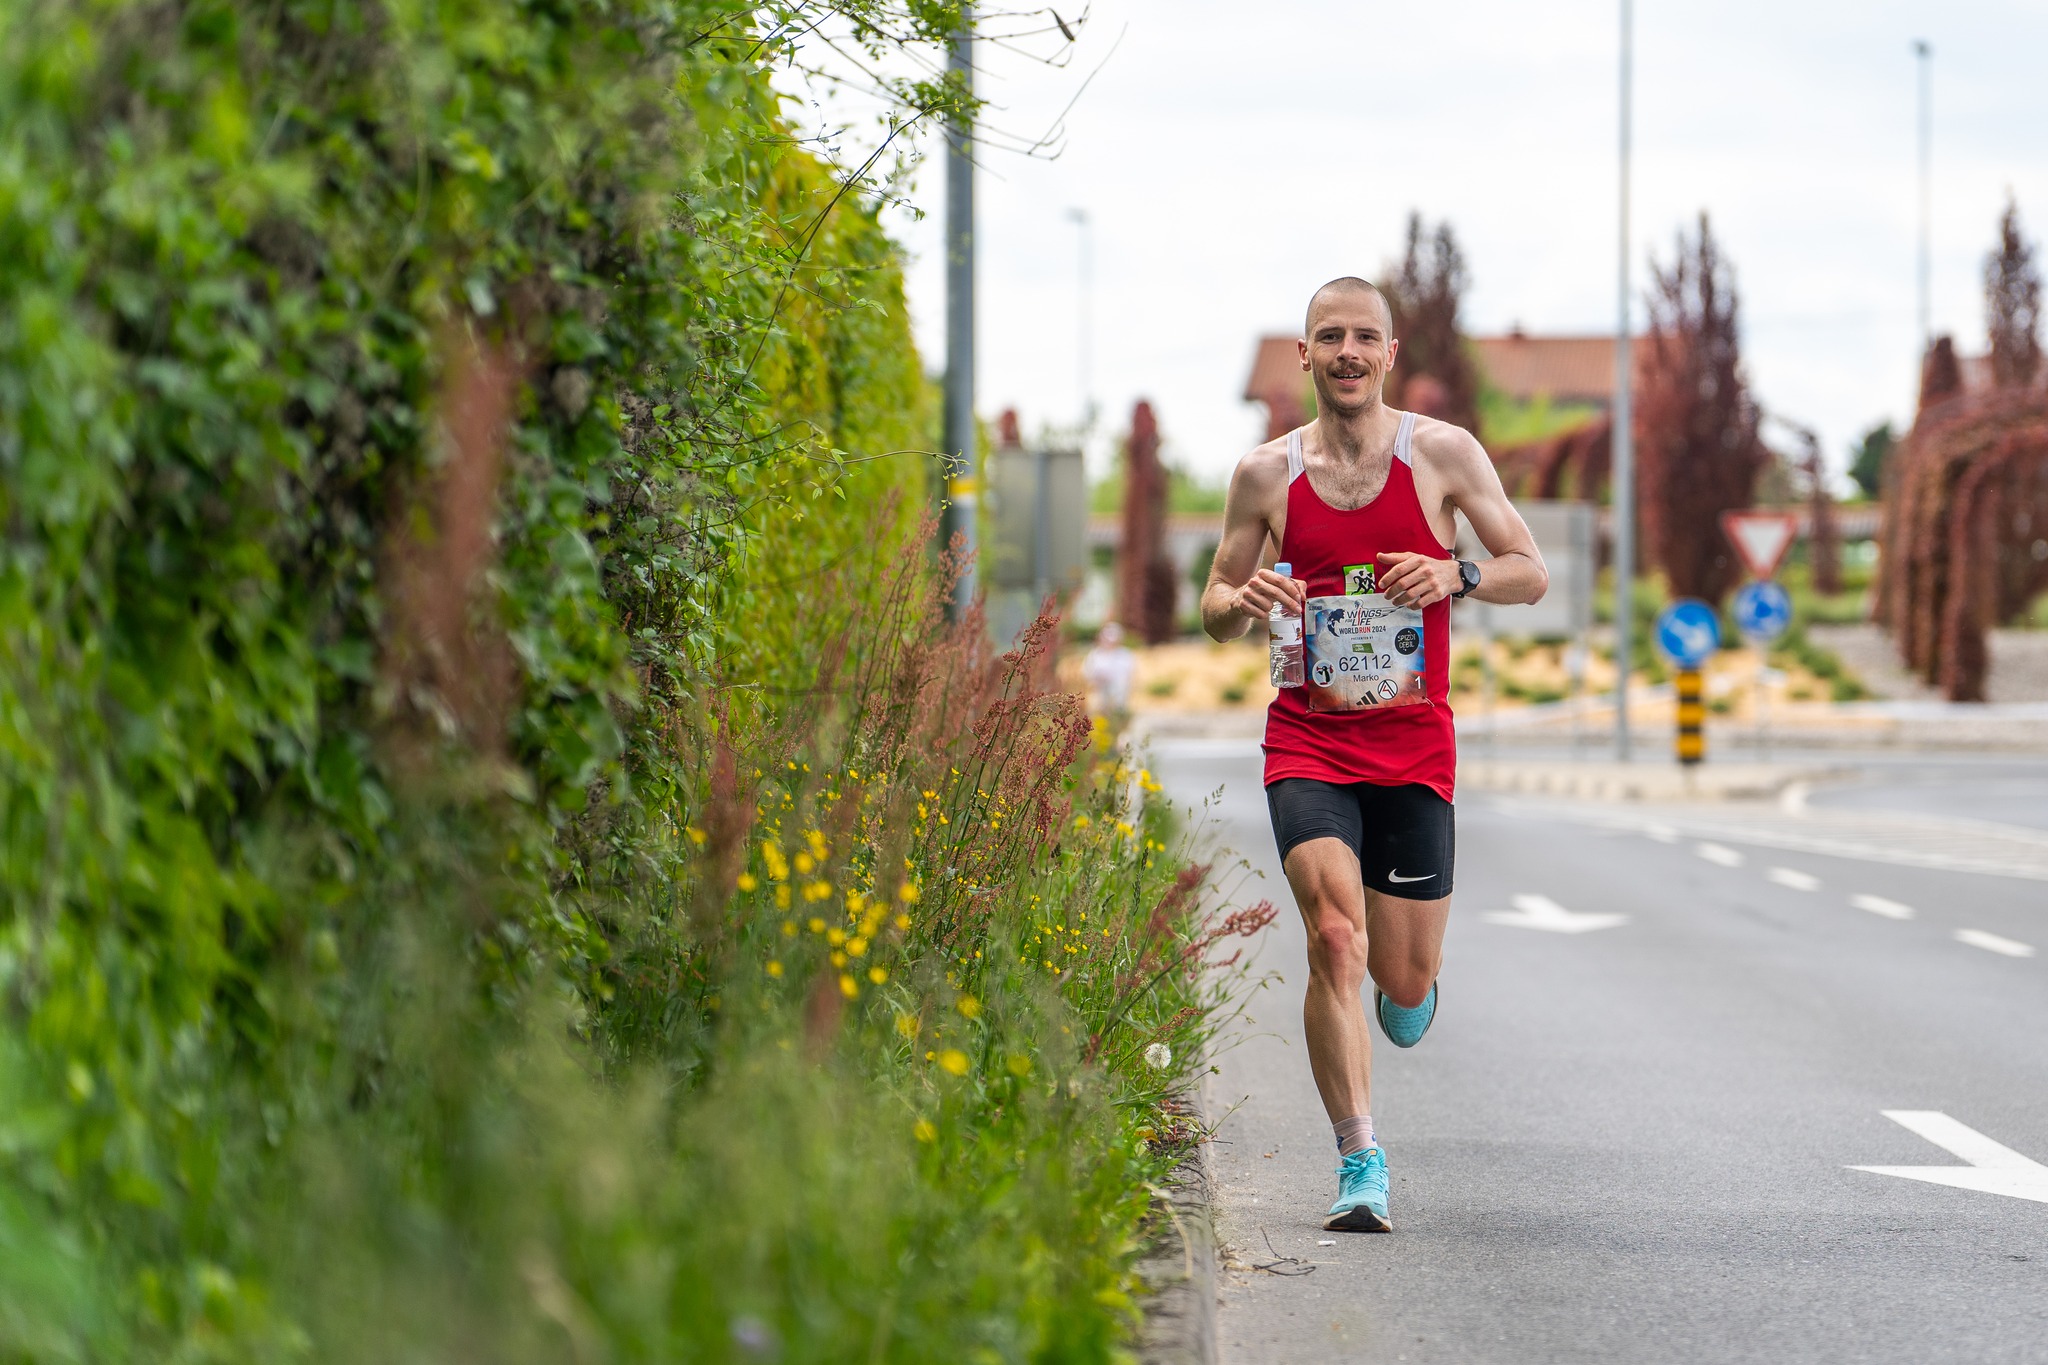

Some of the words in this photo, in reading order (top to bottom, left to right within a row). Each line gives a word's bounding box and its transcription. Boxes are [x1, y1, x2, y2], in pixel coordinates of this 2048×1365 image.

[1347, 608, 1382, 618] WINGS
[1352, 618, 1371, 626] LIFE
[1372, 625, 1386, 633] 2024
[1339, 654, 1391, 672] 62112
[1353, 674, 1380, 682] Marko
[1415, 676, 1422, 689] 1
